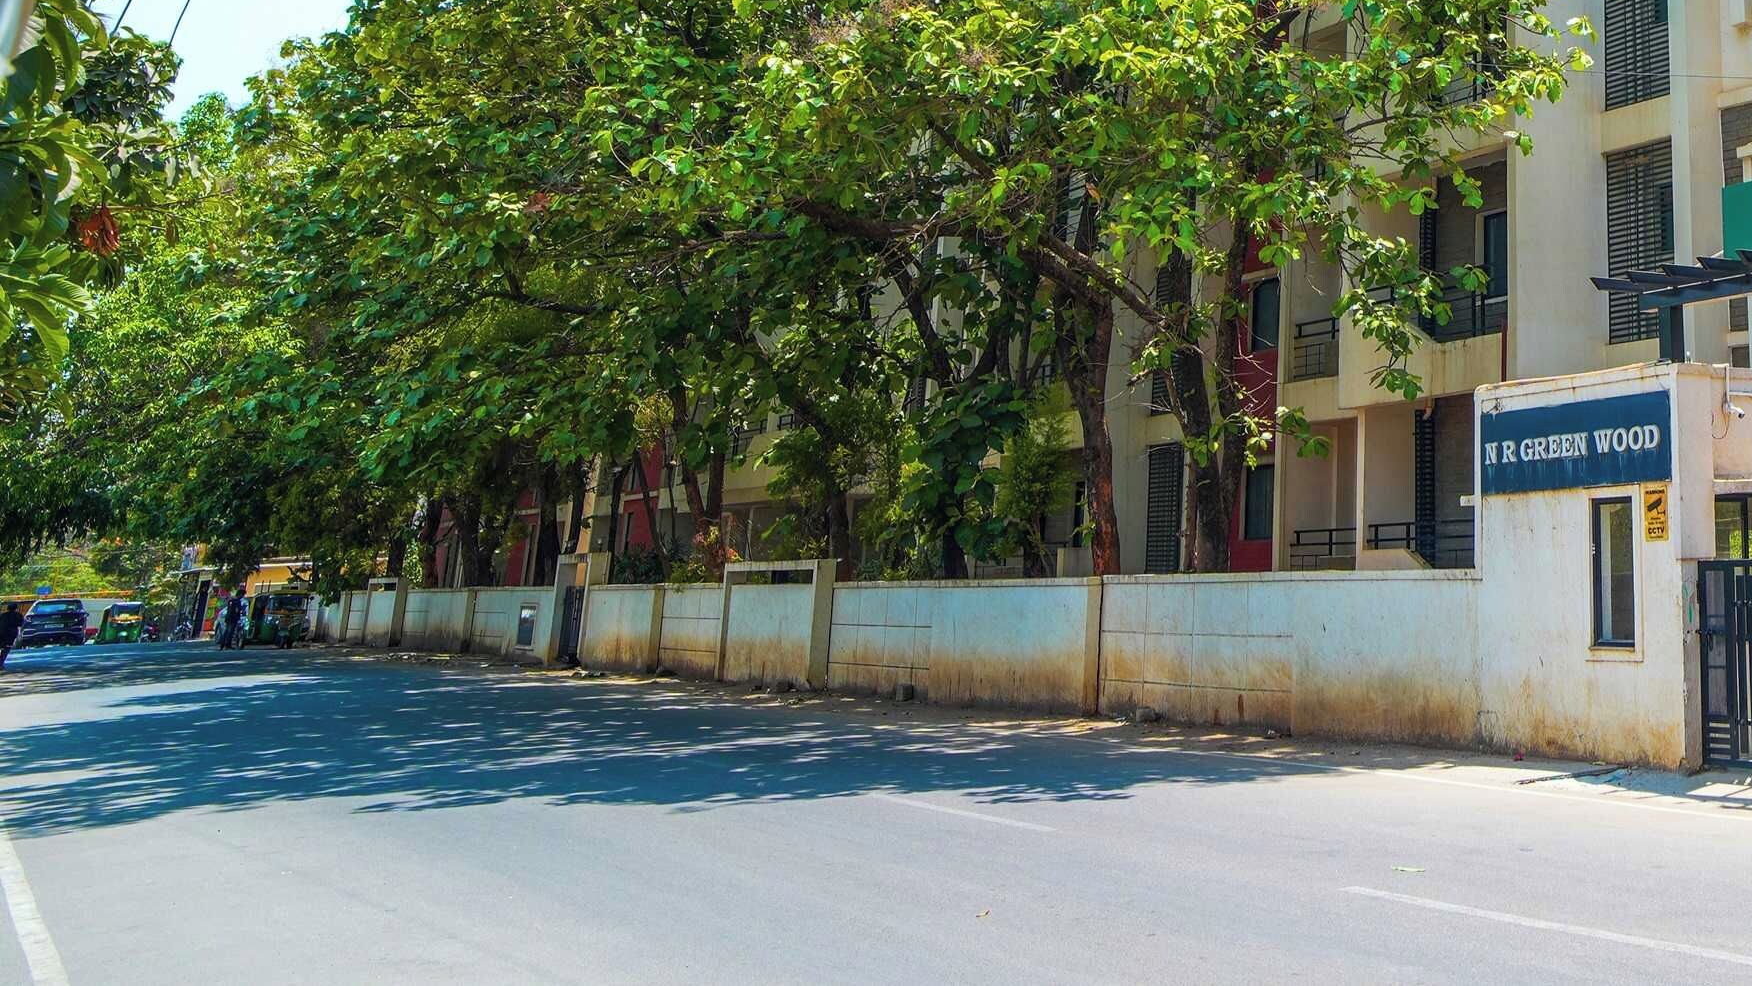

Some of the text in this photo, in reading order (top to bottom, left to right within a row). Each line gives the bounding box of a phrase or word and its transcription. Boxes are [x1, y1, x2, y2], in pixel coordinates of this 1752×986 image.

[1520, 432, 1588, 461] GREEN
[1593, 425, 1660, 453] WOOD
[1647, 526, 1664, 535] CCTV
